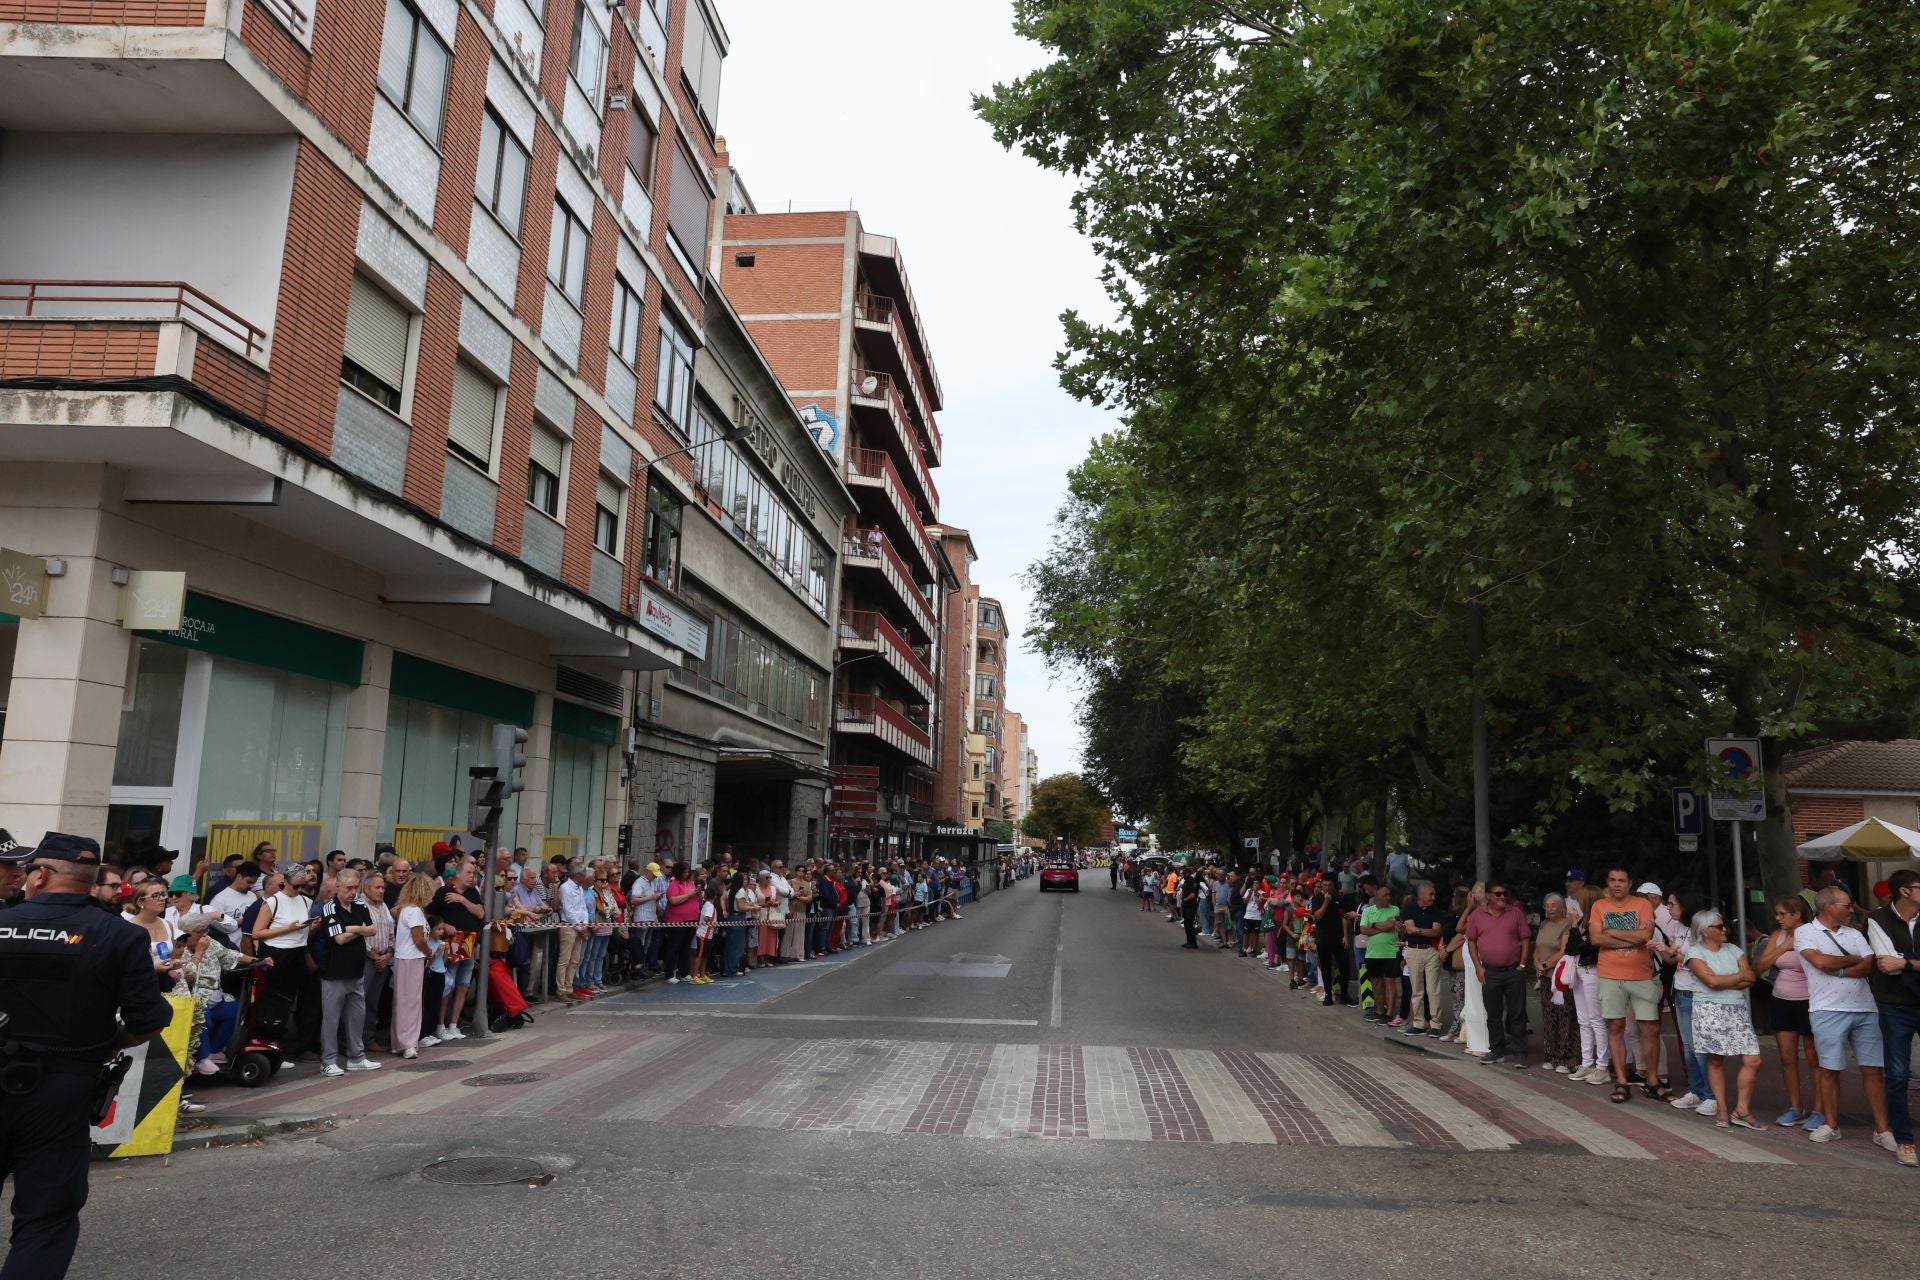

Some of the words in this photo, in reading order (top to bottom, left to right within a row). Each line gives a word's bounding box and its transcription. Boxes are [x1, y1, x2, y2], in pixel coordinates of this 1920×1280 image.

[782, 462, 816, 519] OLIMPIA
[10, 582, 38, 605] 24h
[183, 616, 215, 634] ROCAJA
[1677, 792, 1695, 829] P
[936, 825, 974, 835] terraza
[0, 927, 69, 942] OLICIA
